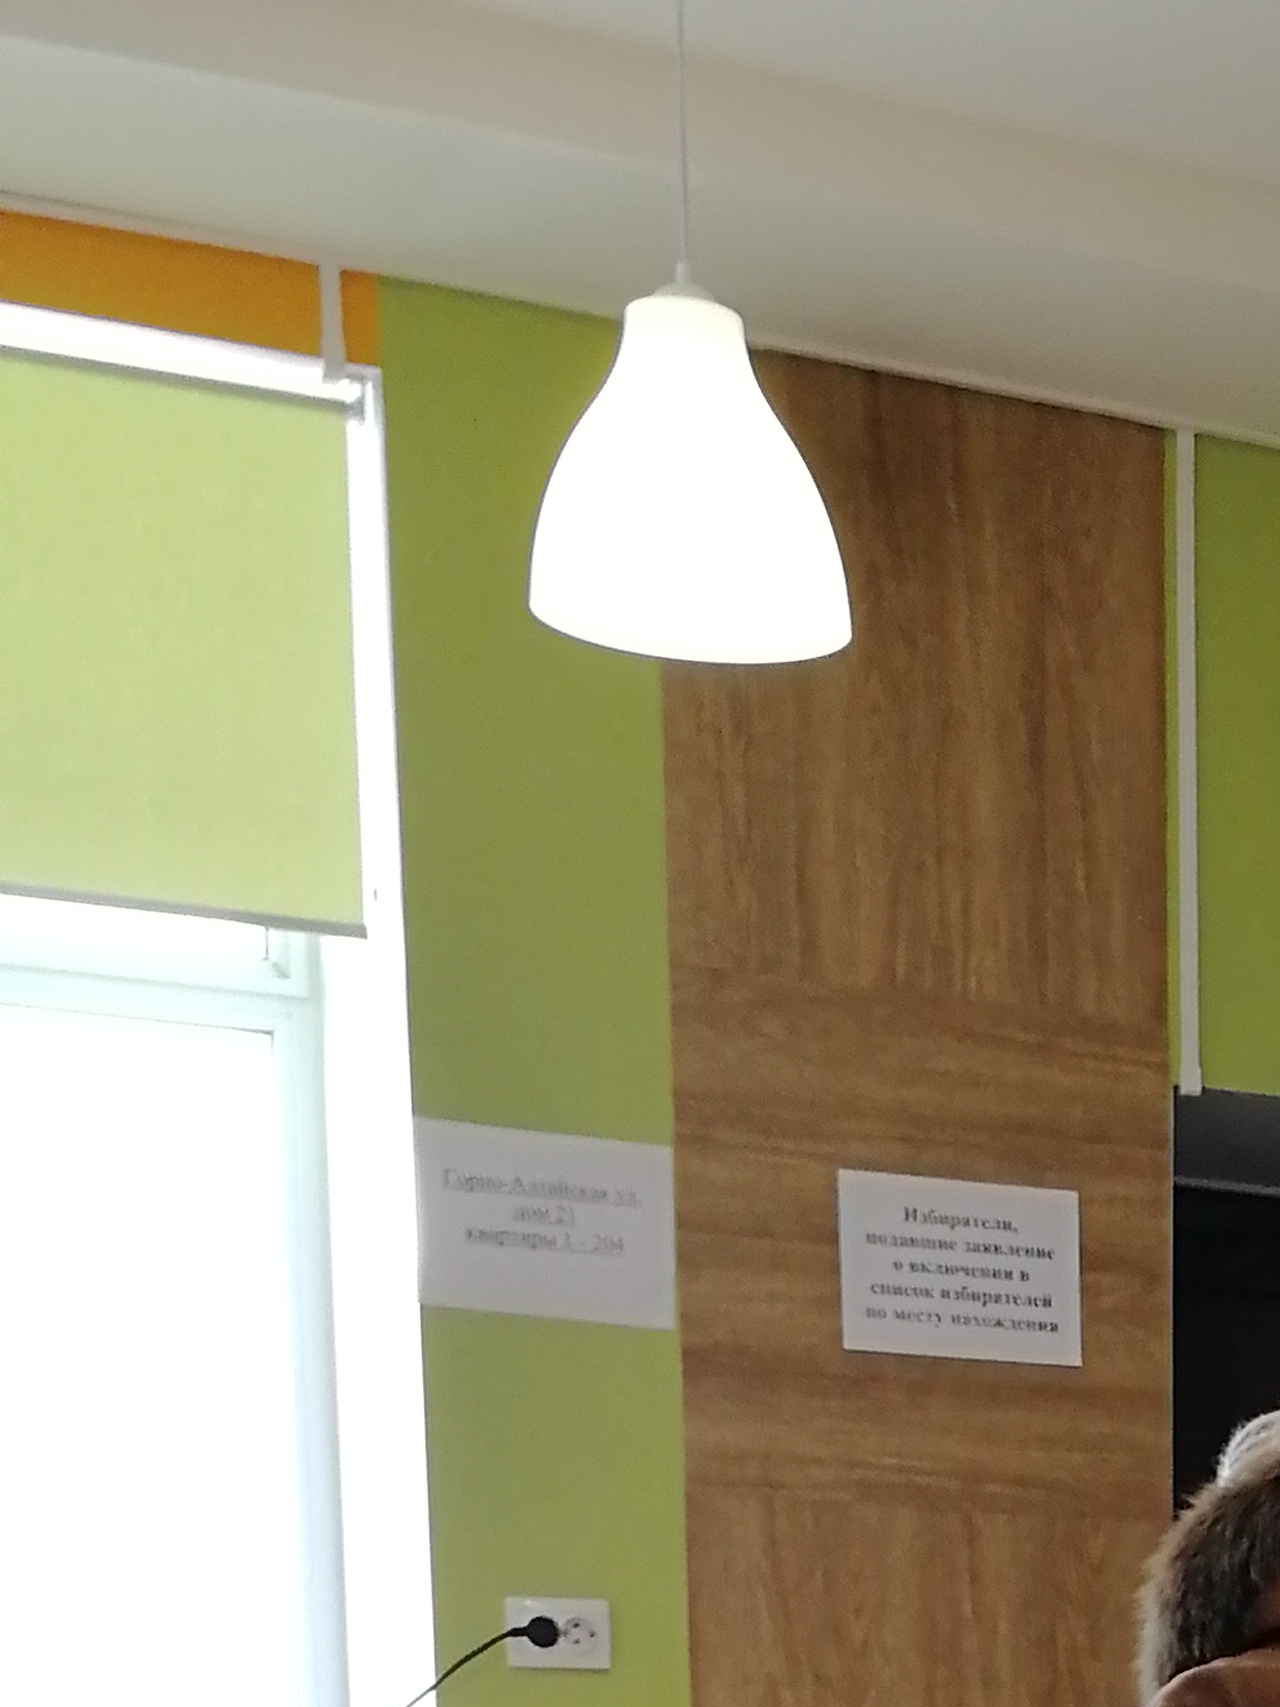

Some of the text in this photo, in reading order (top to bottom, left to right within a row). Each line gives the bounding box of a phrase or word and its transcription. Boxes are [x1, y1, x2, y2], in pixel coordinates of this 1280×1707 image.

[903, 1206, 1018, 1233] Избиратели,
[866, 1232, 958, 1252] подавшие
[870, 1282, 1053, 1309] список избирателей
[894, 1309, 942, 1328] месту
